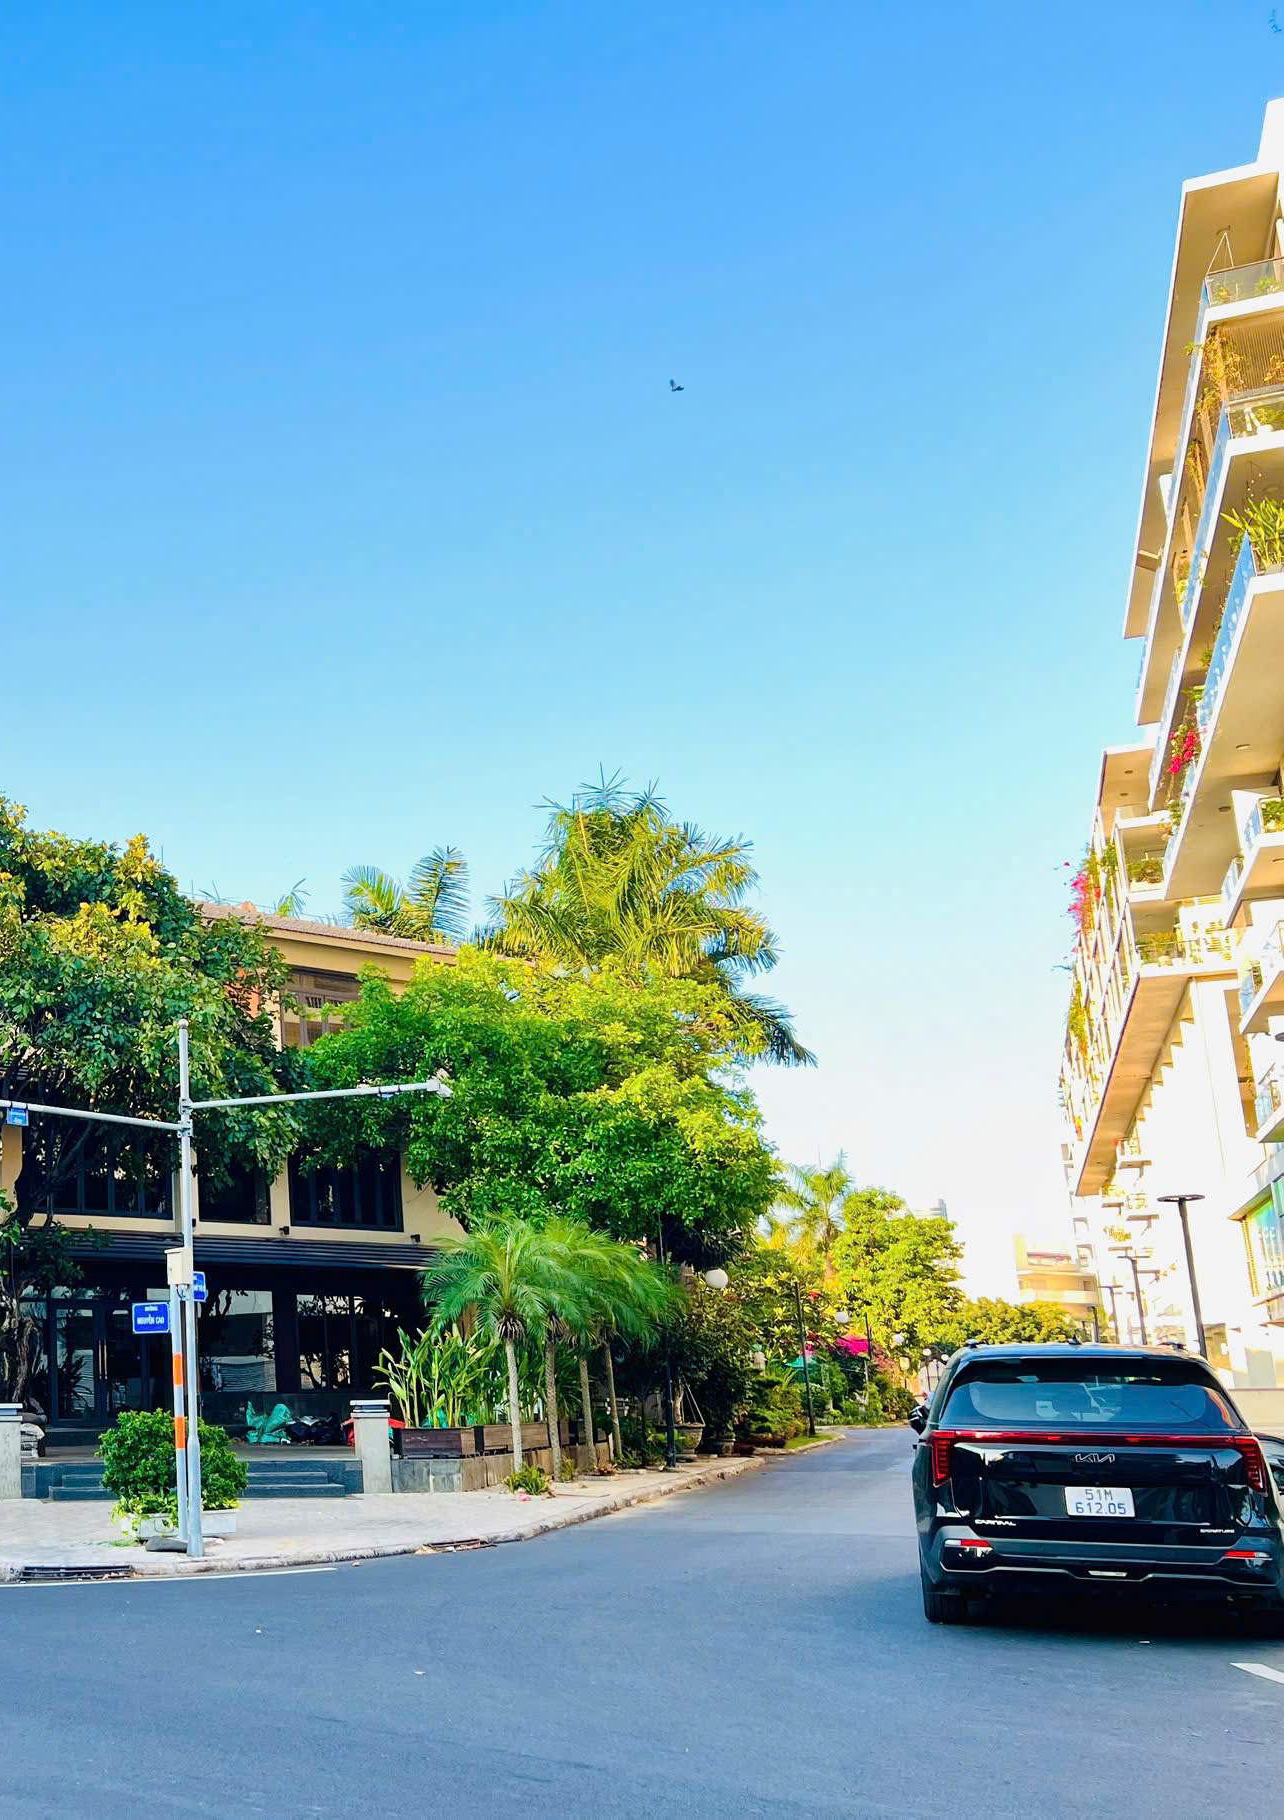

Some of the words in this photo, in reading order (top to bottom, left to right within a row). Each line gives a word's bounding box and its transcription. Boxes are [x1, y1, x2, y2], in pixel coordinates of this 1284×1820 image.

[155, 1316, 164, 1325] CAO
[1074, 1453, 1116, 1463] KIA
[1084, 1488, 1113, 1501] 51M
[1075, 1501, 1127, 1515] 612.05
